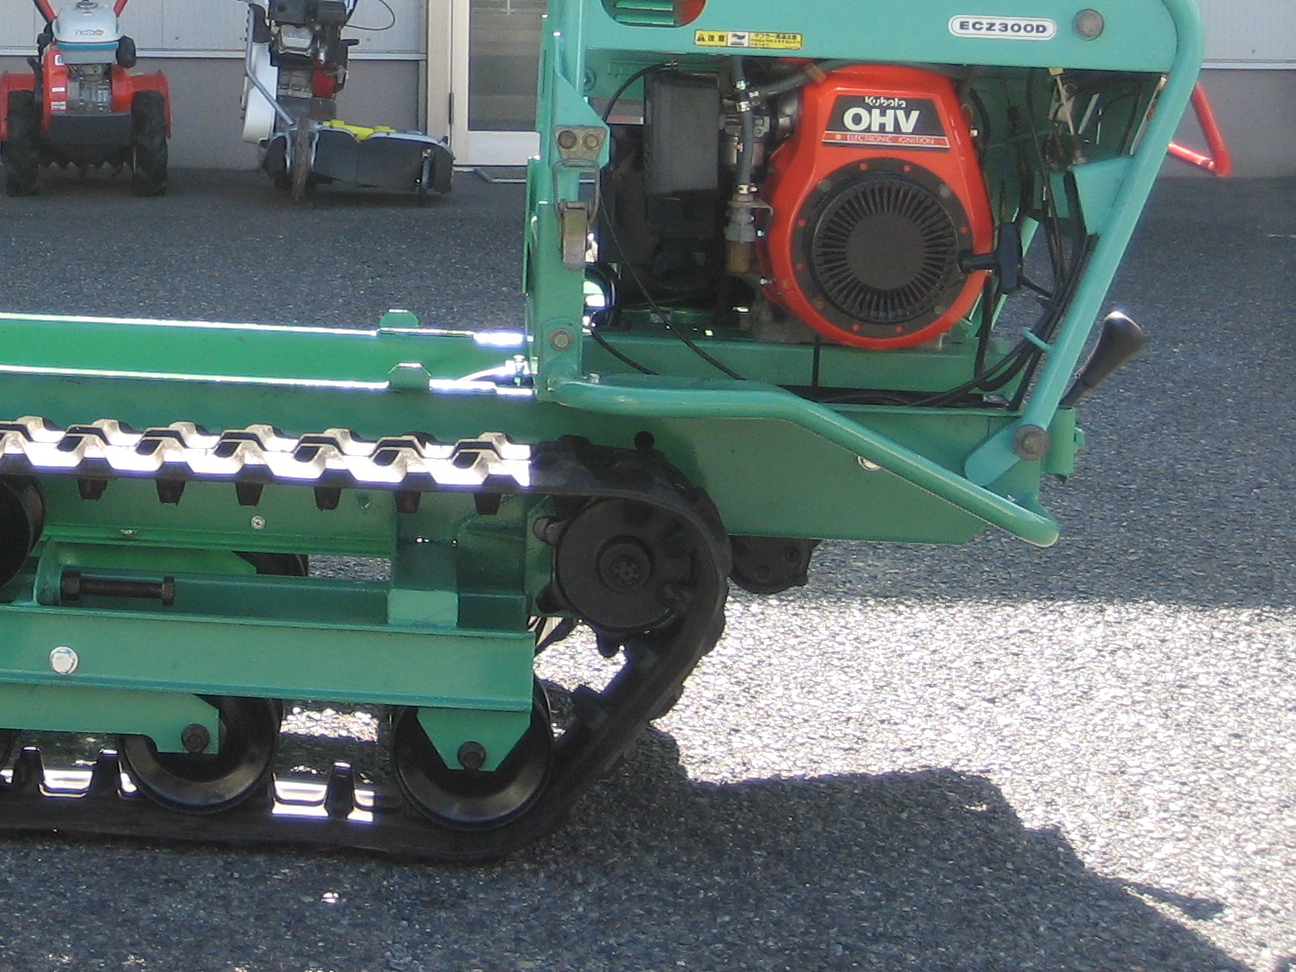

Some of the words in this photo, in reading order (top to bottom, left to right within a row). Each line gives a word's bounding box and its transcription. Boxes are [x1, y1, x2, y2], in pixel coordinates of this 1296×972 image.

[959, 21, 1047, 34] ECZ300D
[865, 96, 906, 108] Kubota
[843, 107, 921, 133] OHV
